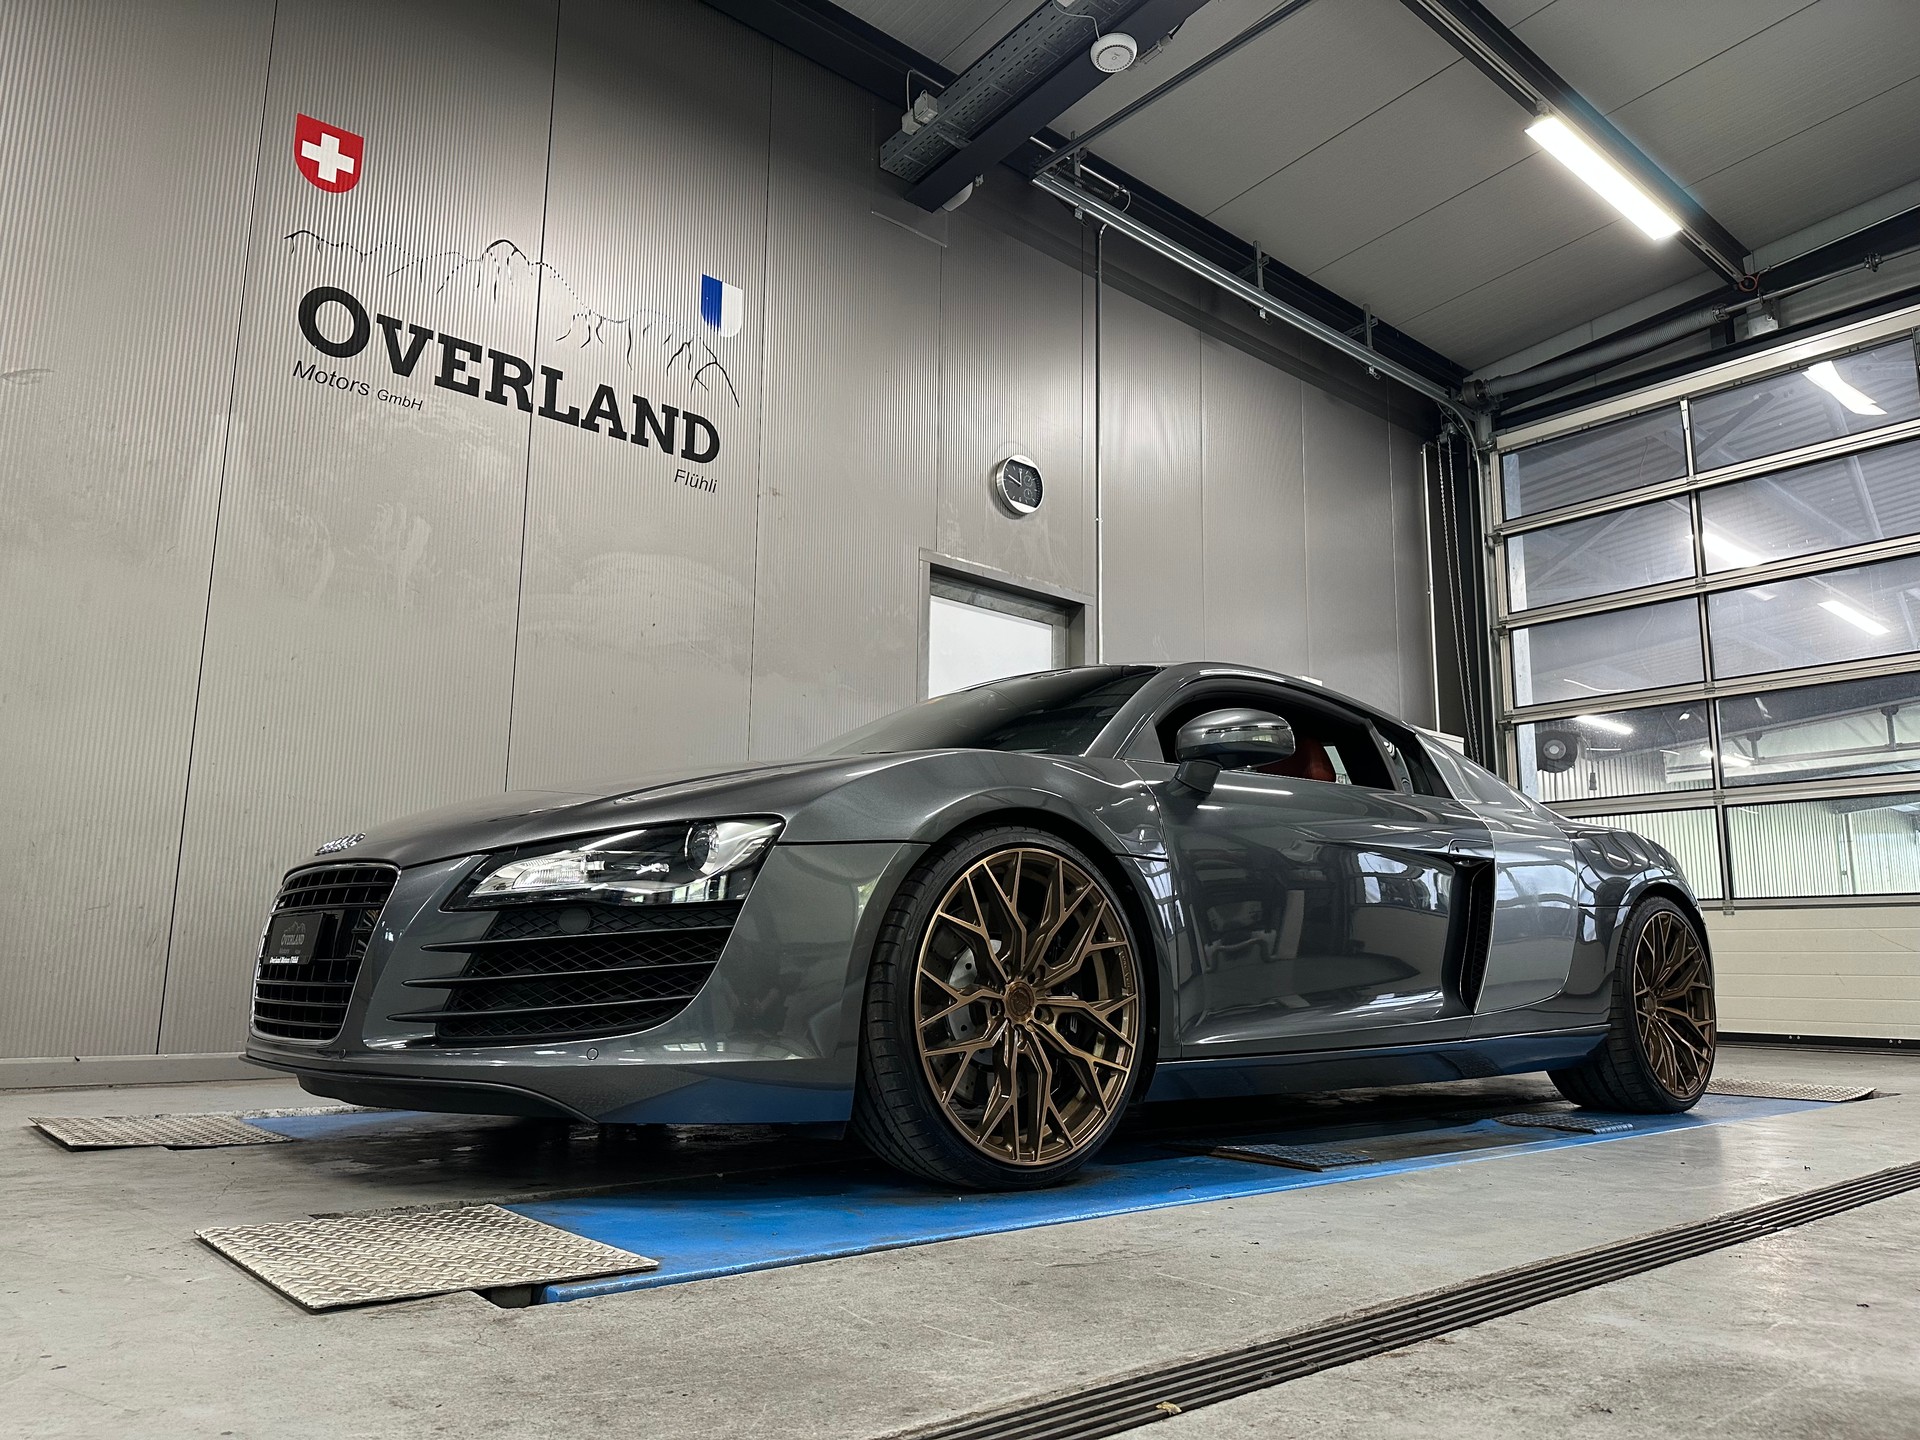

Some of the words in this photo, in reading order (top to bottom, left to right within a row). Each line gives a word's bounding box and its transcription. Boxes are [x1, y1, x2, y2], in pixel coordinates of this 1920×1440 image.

[292, 360, 370, 396] Motors
[377, 389, 423, 411] GmbH
[298, 286, 720, 463] OVERLAND
[674, 468, 718, 493] Flühli
